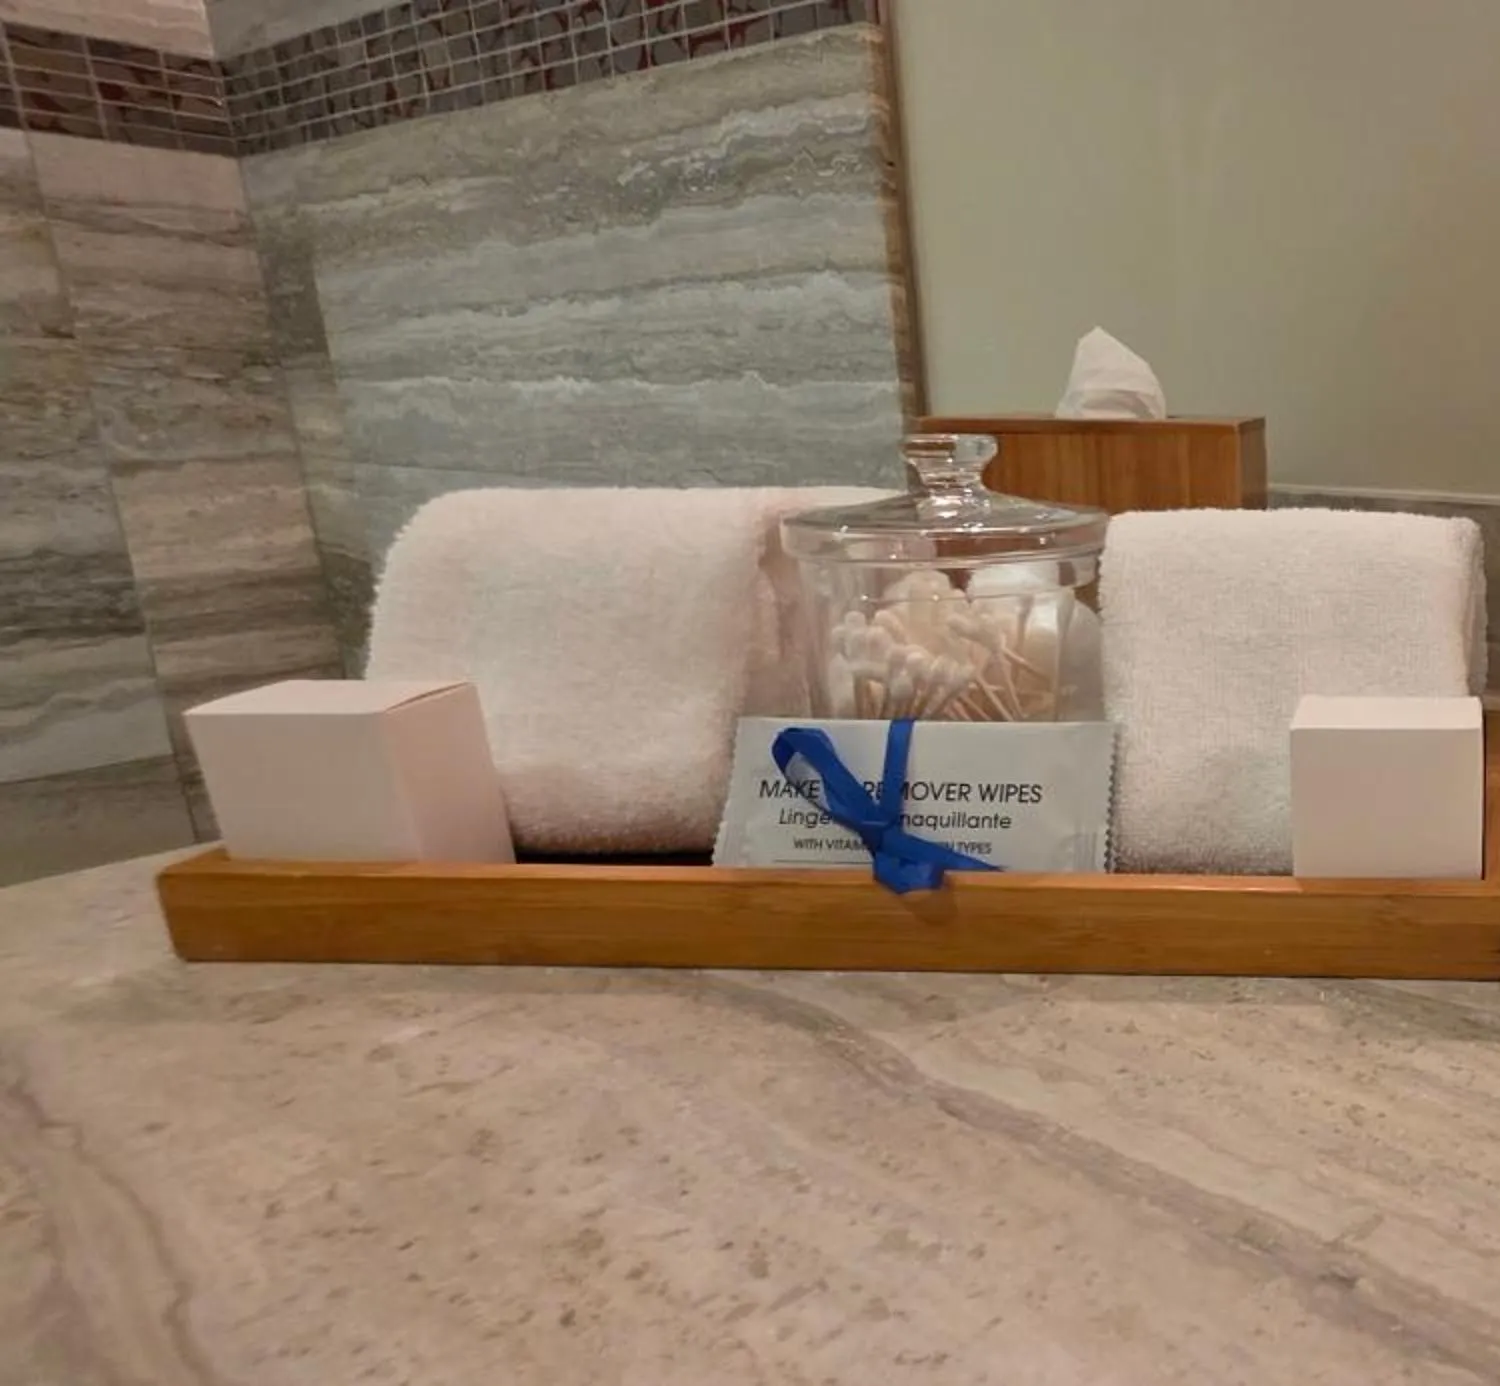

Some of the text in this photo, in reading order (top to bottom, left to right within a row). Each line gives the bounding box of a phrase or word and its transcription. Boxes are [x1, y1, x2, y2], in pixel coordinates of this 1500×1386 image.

[759, 779, 821, 800] MAKE
[978, 783, 1043, 804] WIPES
[793, 837, 823, 850] WITH
[957, 841, 992, 855] TYPES
